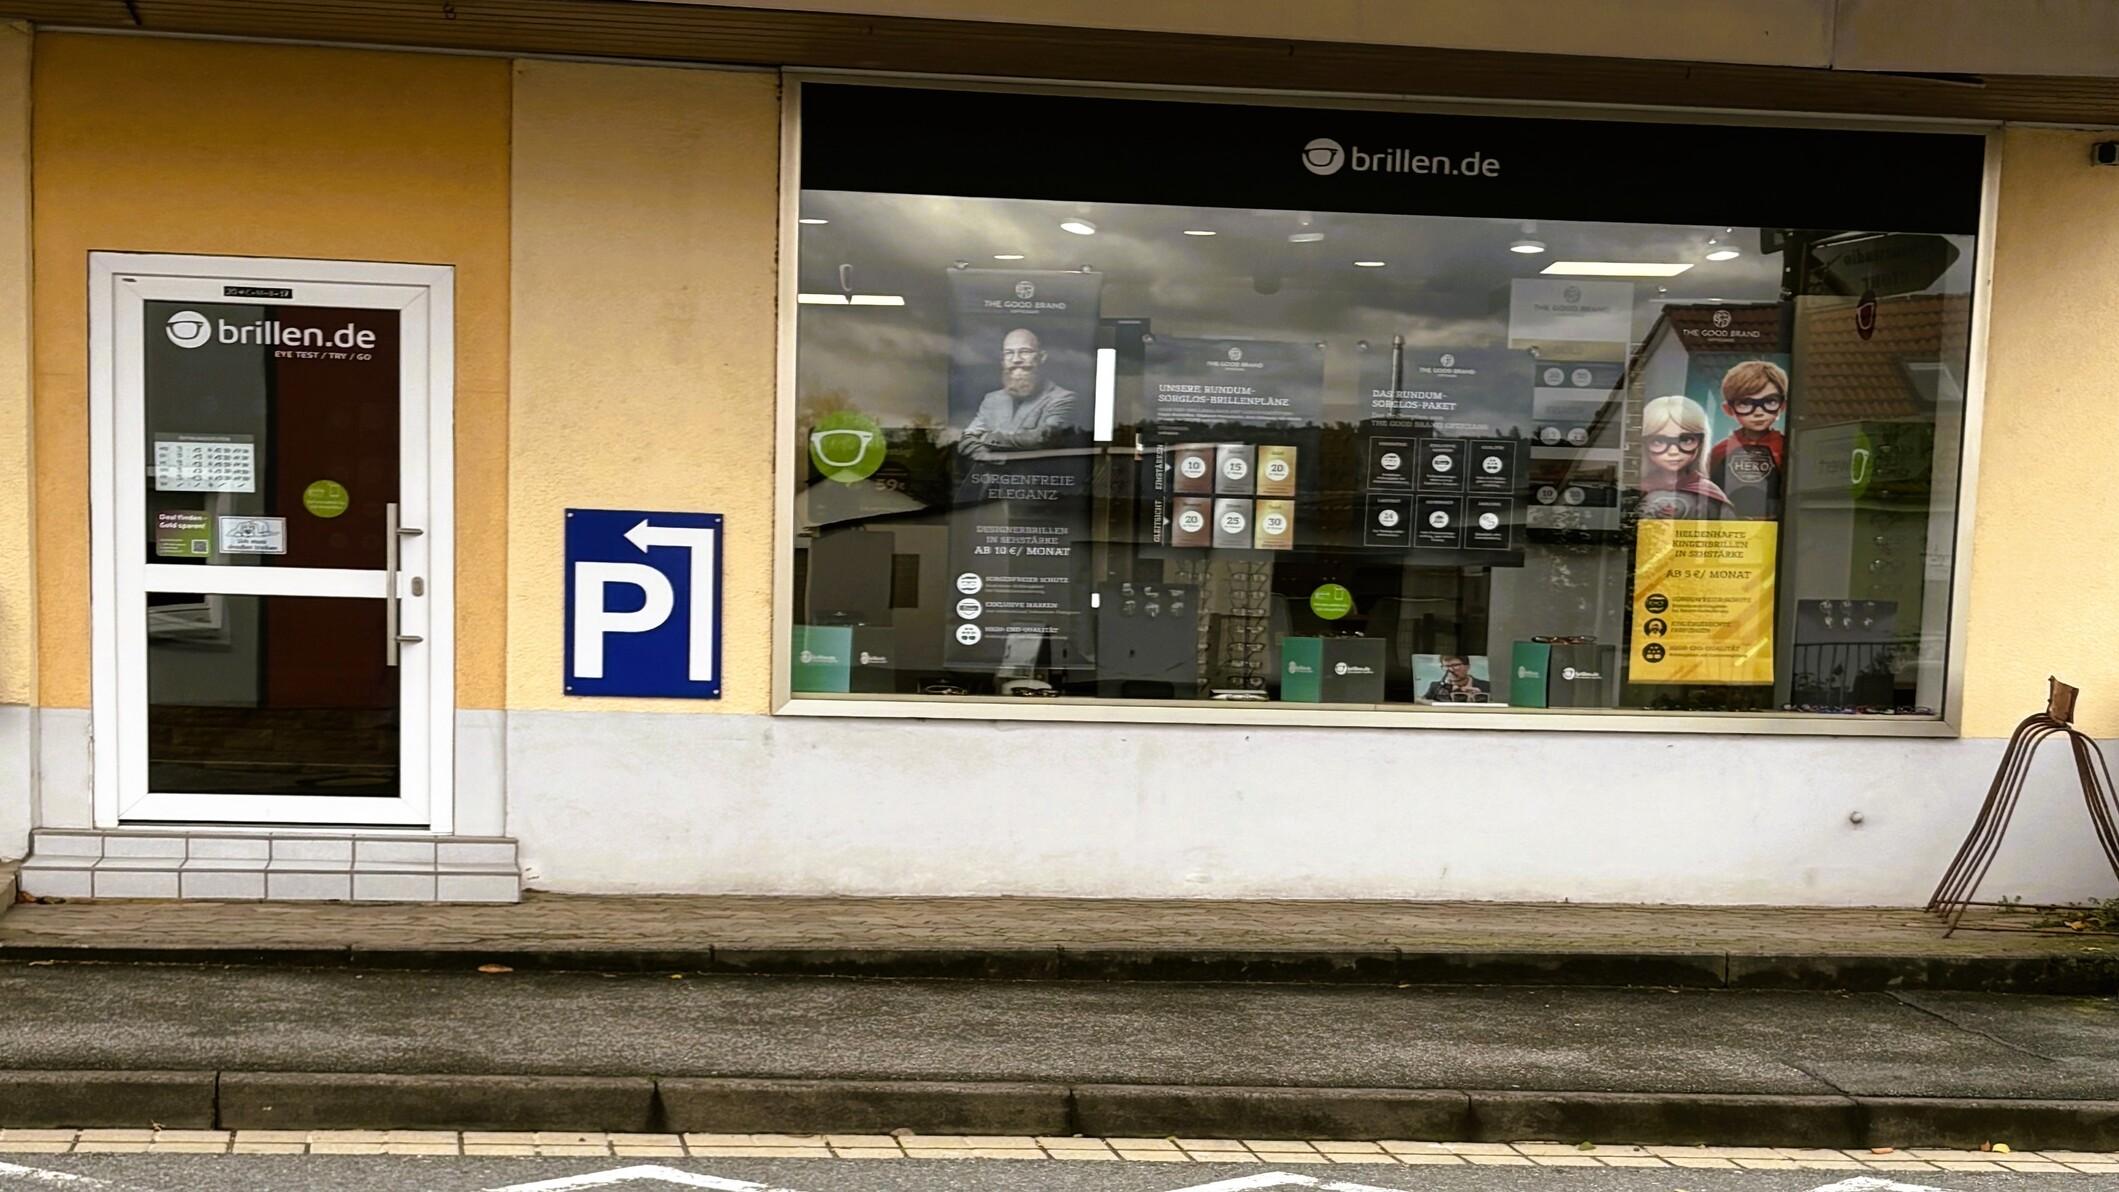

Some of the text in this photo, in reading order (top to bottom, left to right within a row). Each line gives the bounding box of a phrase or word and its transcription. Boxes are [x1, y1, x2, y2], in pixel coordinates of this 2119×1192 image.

[1351, 146, 1500, 177] brillen.de
[983, 299, 1067, 310] THE GOOD BRAND
[218, 318, 376, 349] brillen.de
[1683, 328, 1760, 338] THE GOOD BRAND
[274, 350, 293, 358] EYE
[296, 351, 318, 359] TEST
[1159, 384, 1256, 395] UNSERE RUNDUM-
[1372, 389, 1448, 400] DAS RUNDUM-
[1157, 394, 1291, 406] SORGLOS-BRILLENPLÄNE
[1371, 400, 1457, 411] SORGLOS-PAKET
[1187, 461, 1200, 470] 10
[1229, 463, 1243, 472] 15
[1270, 464, 1285, 473] 20
[1734, 461, 1770, 471] HERO
[971, 473, 1075, 486] SORGENFREIE
[988, 488, 1059, 500] ELEGANZ
[1184, 515, 1198, 525] 20
[1226, 516, 1240, 526] 25
[1267, 518, 1281, 527] 30
[976, 525, 1069, 534] DESIGNERBRILLEN
[1675, 530, 1747, 539] HELDENHAFTE
[1000, 535, 1059, 544] SEHSTÄRKE
[1672, 540, 1749, 549] KINDERBRILLEN
[974, 546, 992, 555] AB
[995, 546, 1007, 555] 10
[1026, 547, 1072, 556] MONAT
[1674, 550, 1744, 559] IN SEHSTÄRKE
[1664, 569, 1681, 578] AB
[1684, 570, 1692, 578] 5
[1709, 570, 1752, 579] MONAT
[574, 561, 675, 679] P
